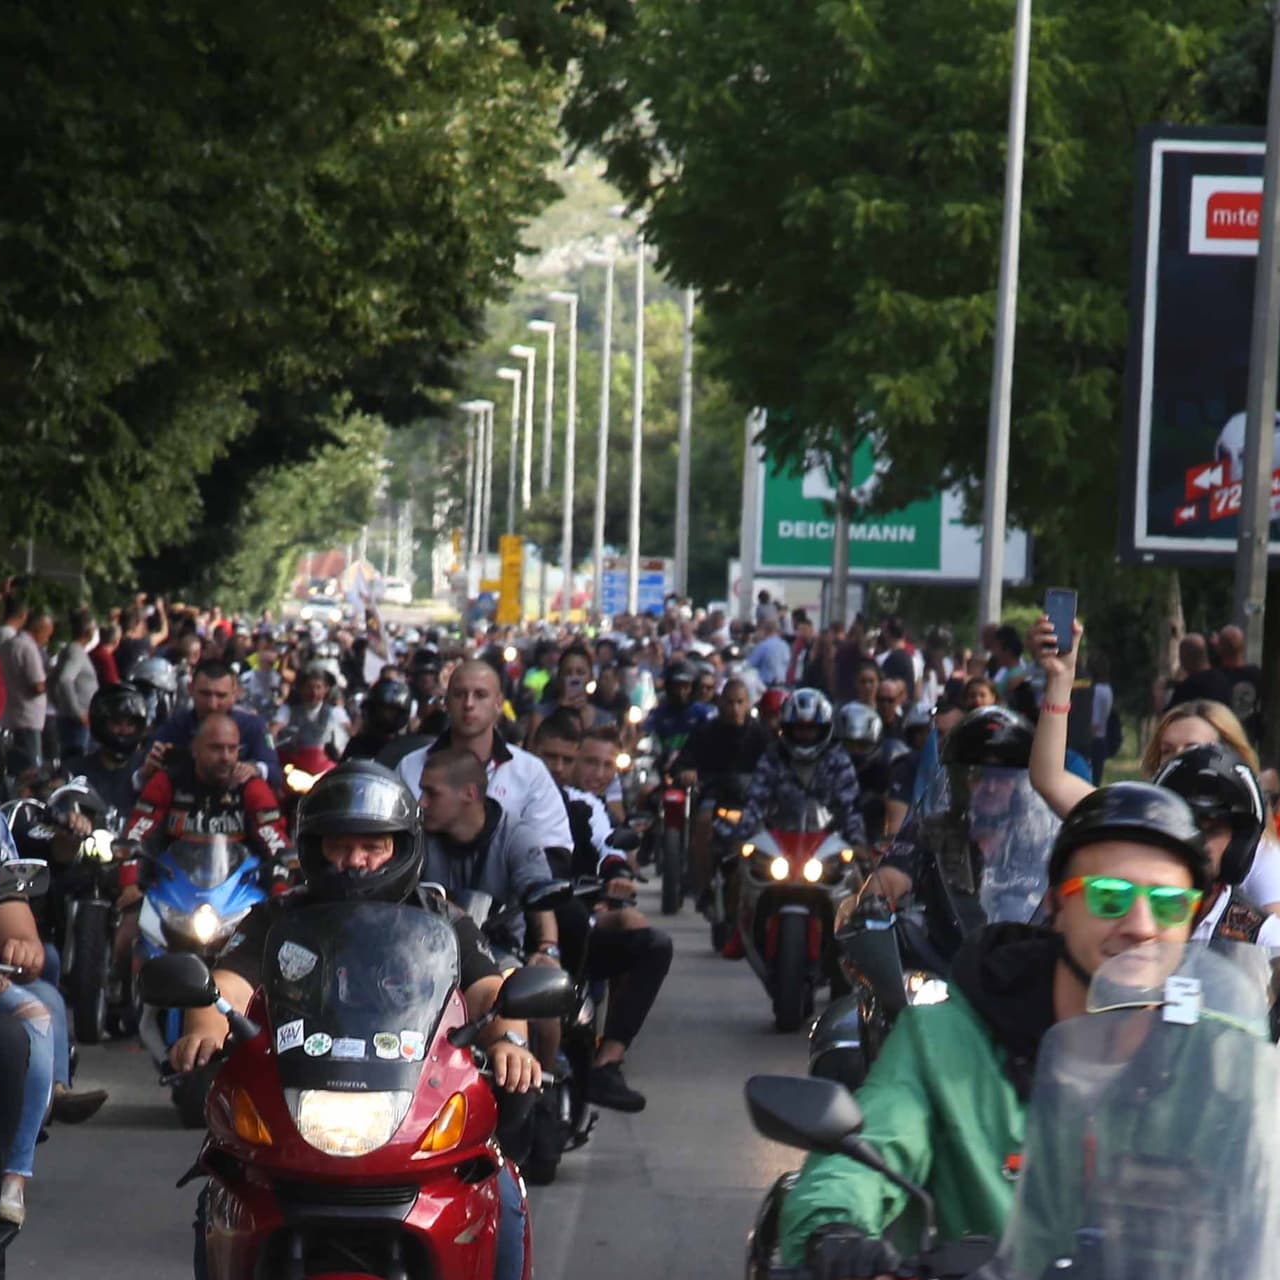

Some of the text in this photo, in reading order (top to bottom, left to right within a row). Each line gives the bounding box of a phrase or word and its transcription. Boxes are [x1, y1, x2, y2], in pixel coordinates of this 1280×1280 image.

[1213, 207, 1260, 226] m:te
[778, 520, 916, 543] DEICMANN
[327, 1080, 368, 1089] HONDA
